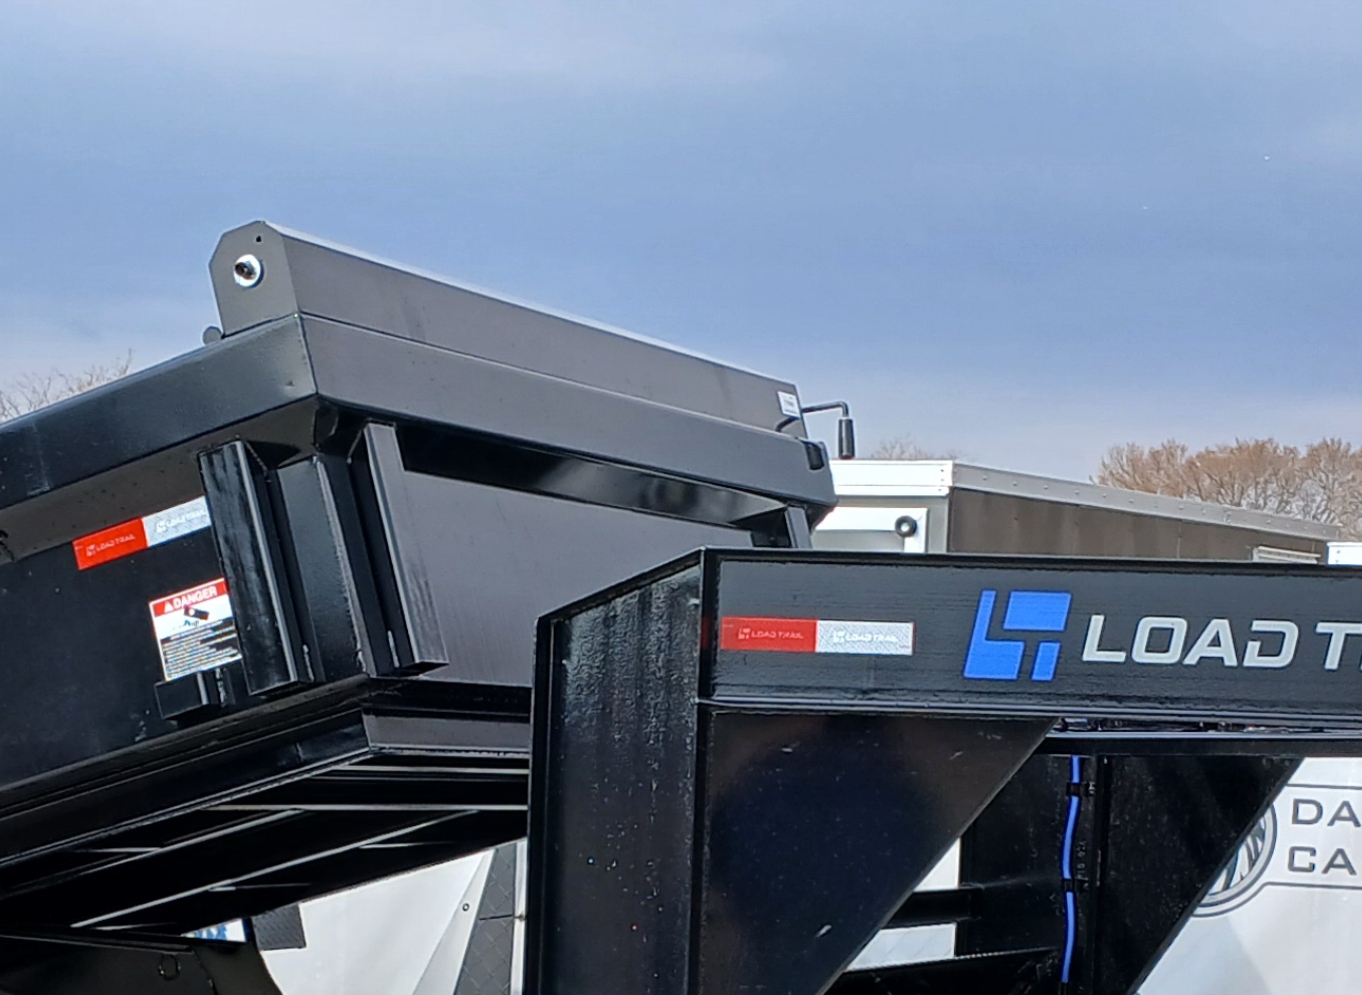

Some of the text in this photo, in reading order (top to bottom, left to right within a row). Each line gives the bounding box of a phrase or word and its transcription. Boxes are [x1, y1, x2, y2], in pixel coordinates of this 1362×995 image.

[172, 585, 218, 609] DANGER
[751, 630, 776, 638] LOAD
[1082, 613, 1299, 668] LOAD
